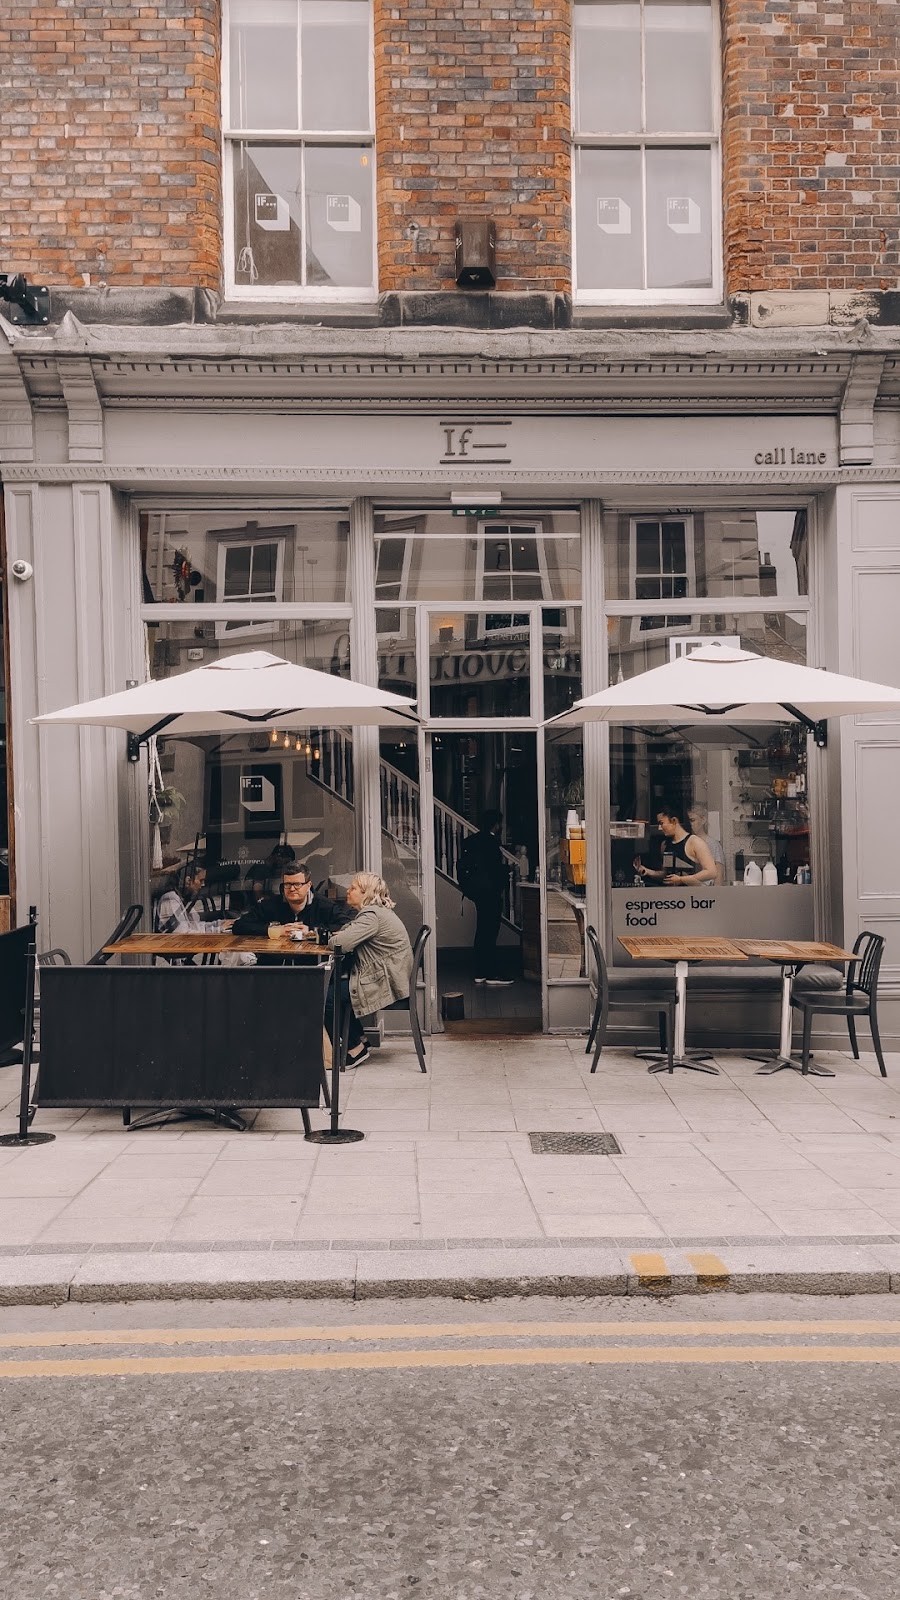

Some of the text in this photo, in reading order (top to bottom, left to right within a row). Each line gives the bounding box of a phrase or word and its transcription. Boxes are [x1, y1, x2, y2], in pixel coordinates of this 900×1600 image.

[754, 447, 827, 465] call lane
[625, 895, 716, 913] espresso bar
[625, 912, 657, 926] food
